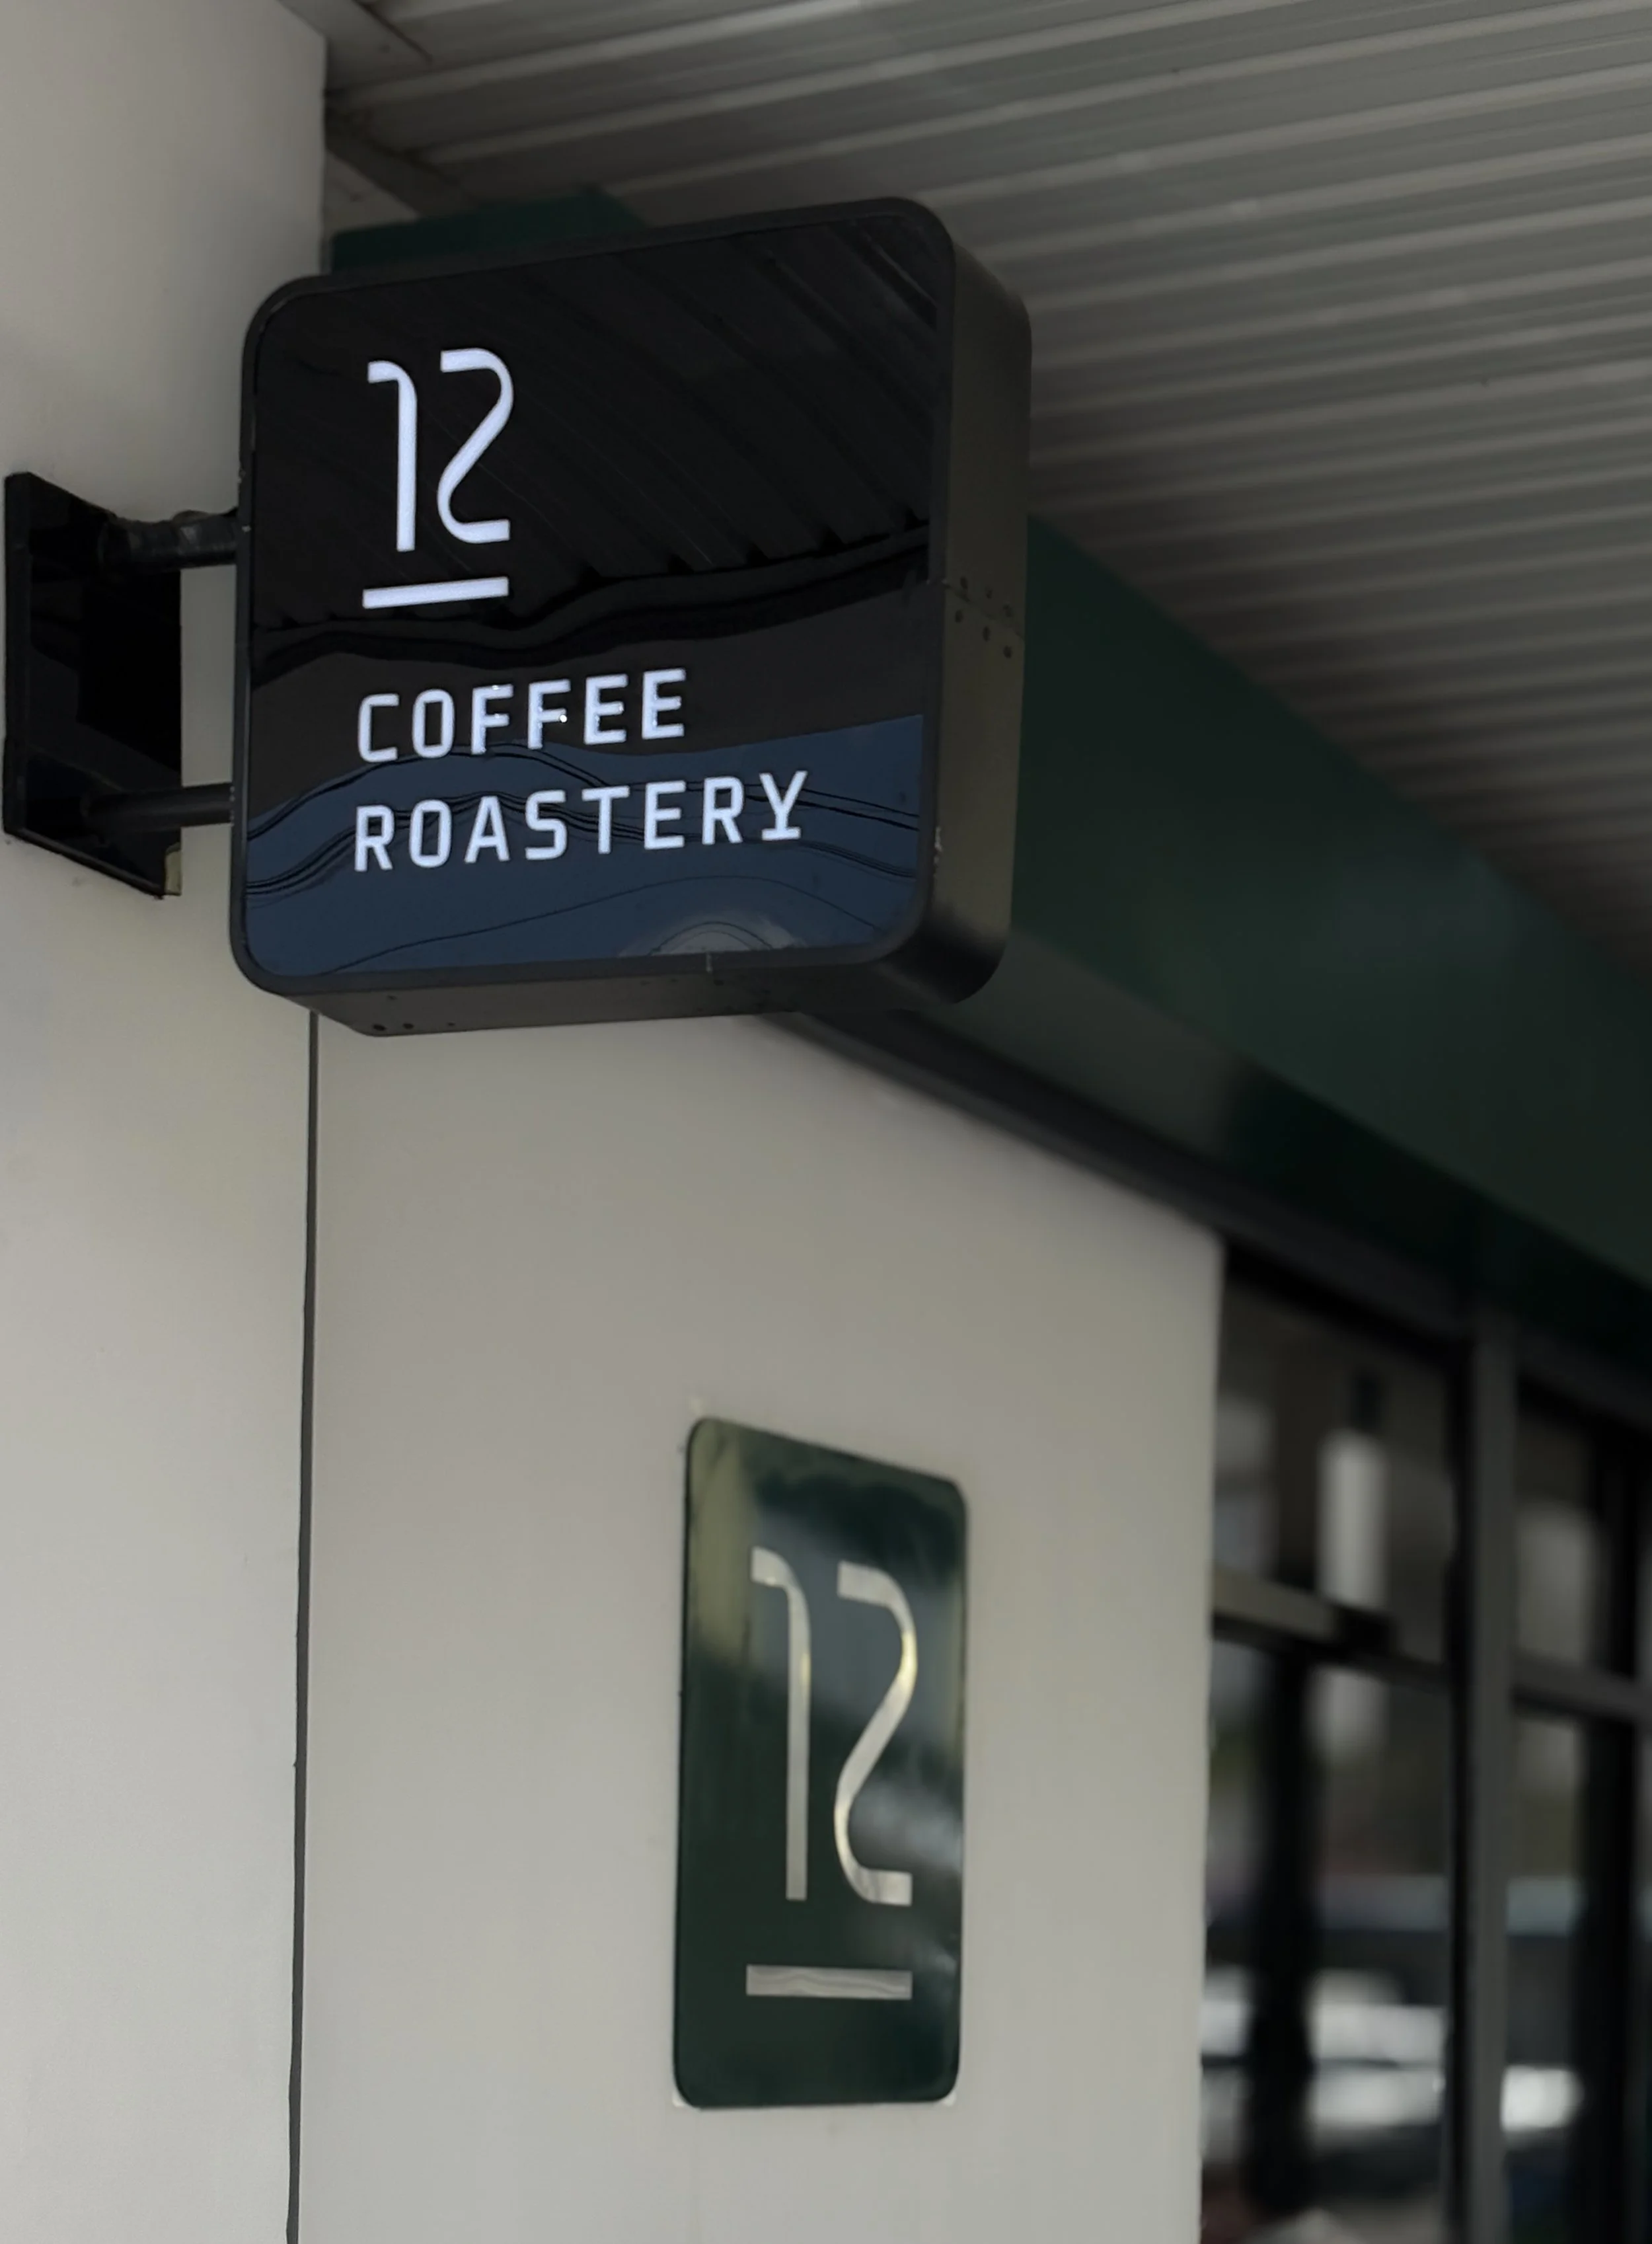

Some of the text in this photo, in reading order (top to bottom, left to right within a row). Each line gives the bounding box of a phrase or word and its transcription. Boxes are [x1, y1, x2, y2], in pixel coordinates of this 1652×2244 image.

[367, 348, 513, 552] 12
[357, 668, 685, 763] COFFEE
[354, 770, 807, 872] ROASTERY
[751, 1546, 919, 1906] 12
